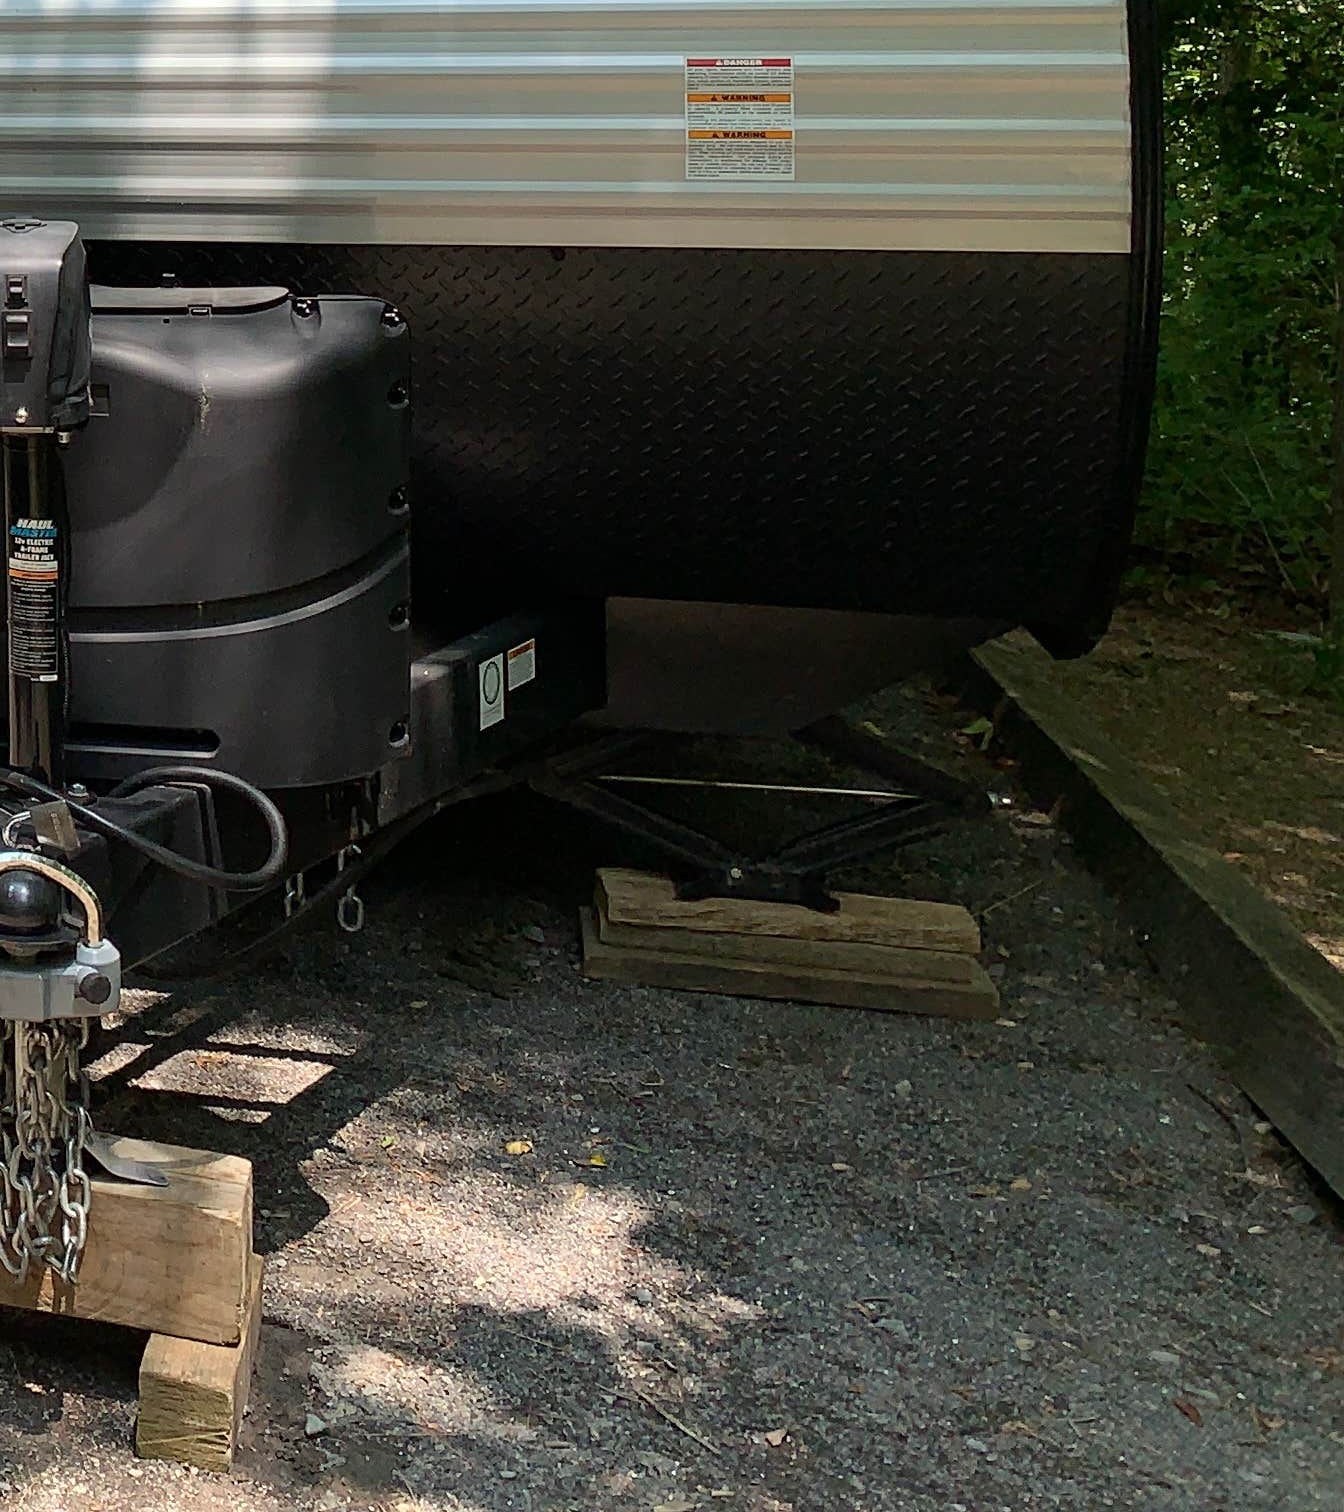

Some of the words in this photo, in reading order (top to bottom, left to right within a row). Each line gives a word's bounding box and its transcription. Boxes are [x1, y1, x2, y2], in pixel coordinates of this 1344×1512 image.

[721, 94, 766, 102] WARNING
[16, 518, 54, 529] HAUL
[20, 545, 49, 553] A-FRAME
[14, 552, 40, 560] TRAILER
